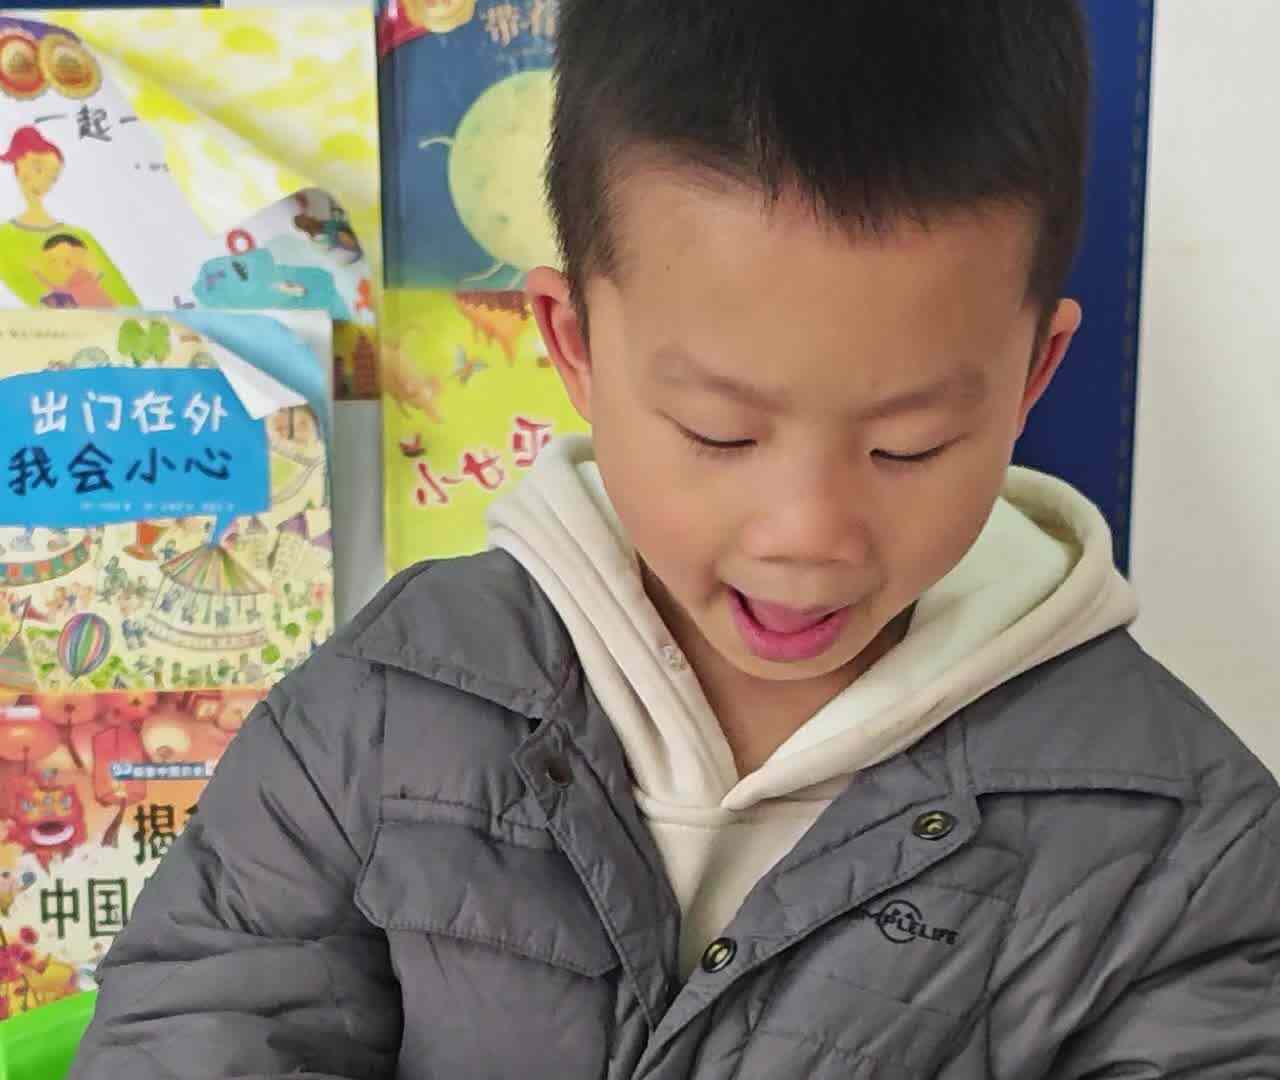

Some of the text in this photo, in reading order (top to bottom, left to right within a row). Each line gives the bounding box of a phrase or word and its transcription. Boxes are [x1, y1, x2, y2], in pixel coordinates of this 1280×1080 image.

[30, 390, 228, 436] 出门在外
[7, 442, 233, 496] 我会小心
